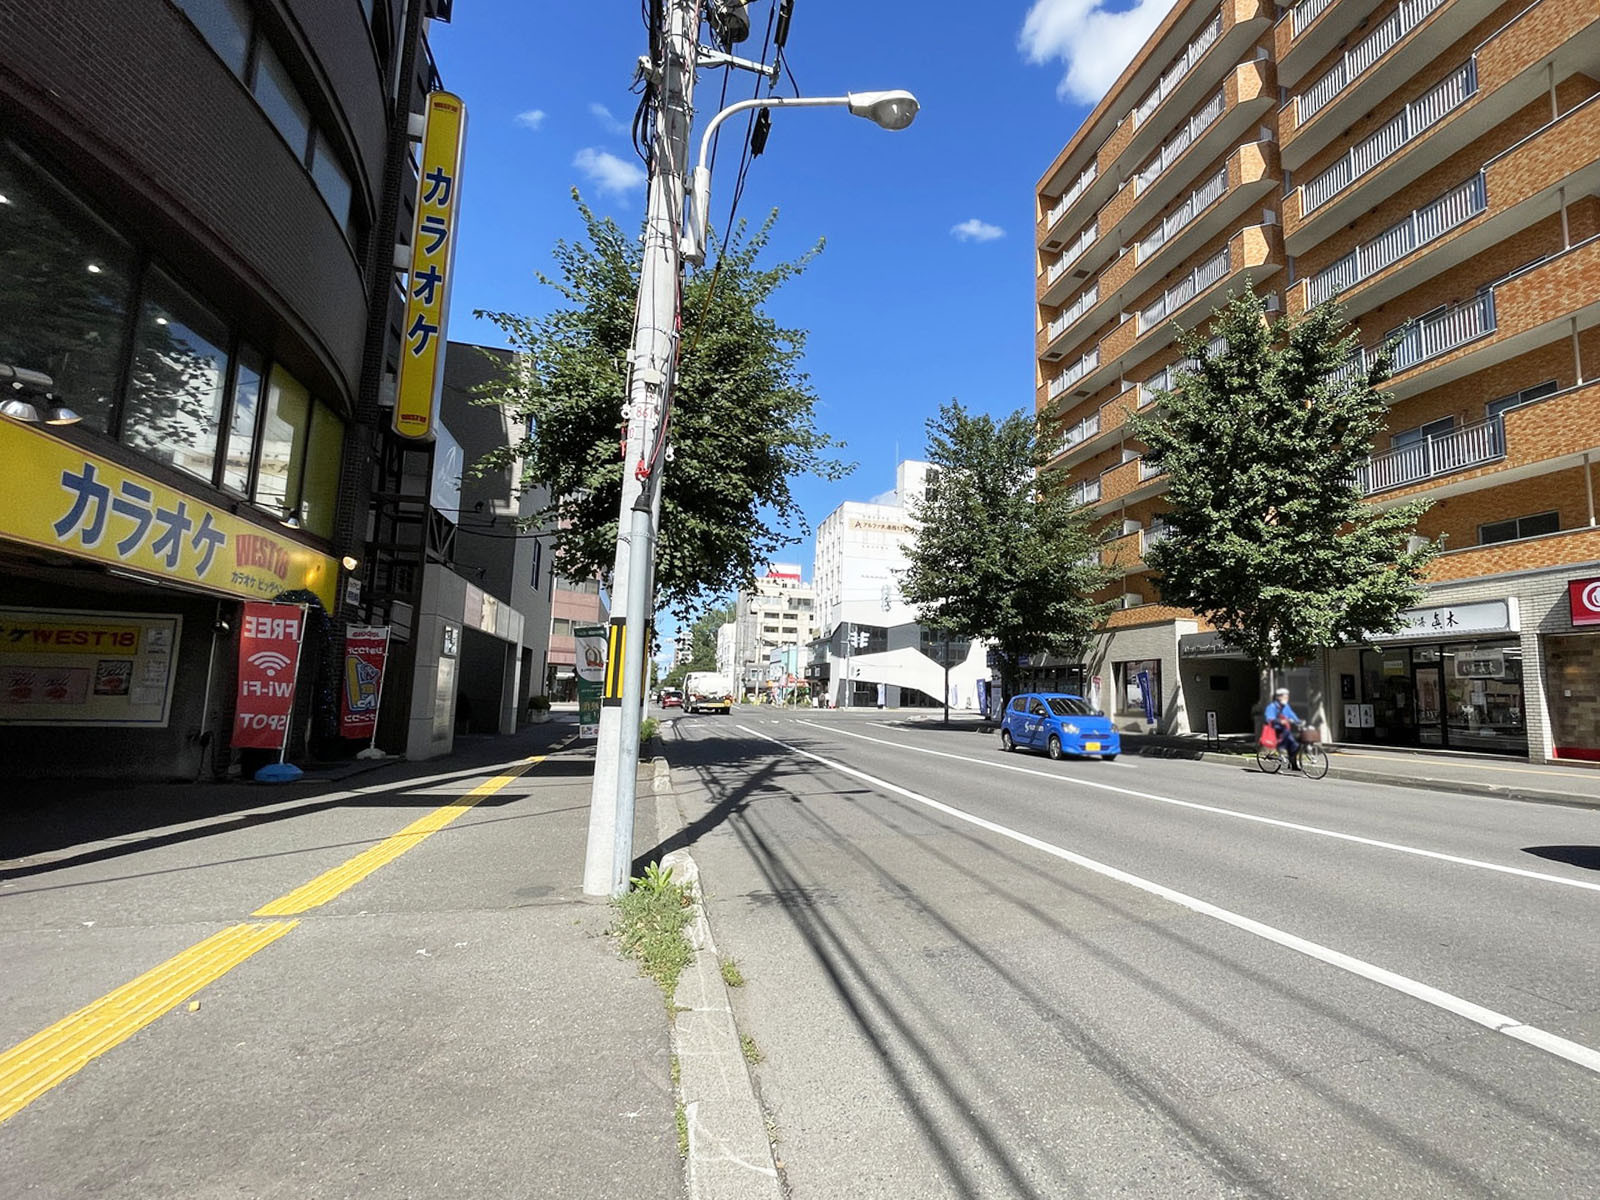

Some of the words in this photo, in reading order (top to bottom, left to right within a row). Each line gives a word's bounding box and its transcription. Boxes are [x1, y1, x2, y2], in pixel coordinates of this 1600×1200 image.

[407, 167, 453, 356] カラオケ
[53, 462, 227, 579] カラオケ
[235, 534, 290, 580] WEST18
